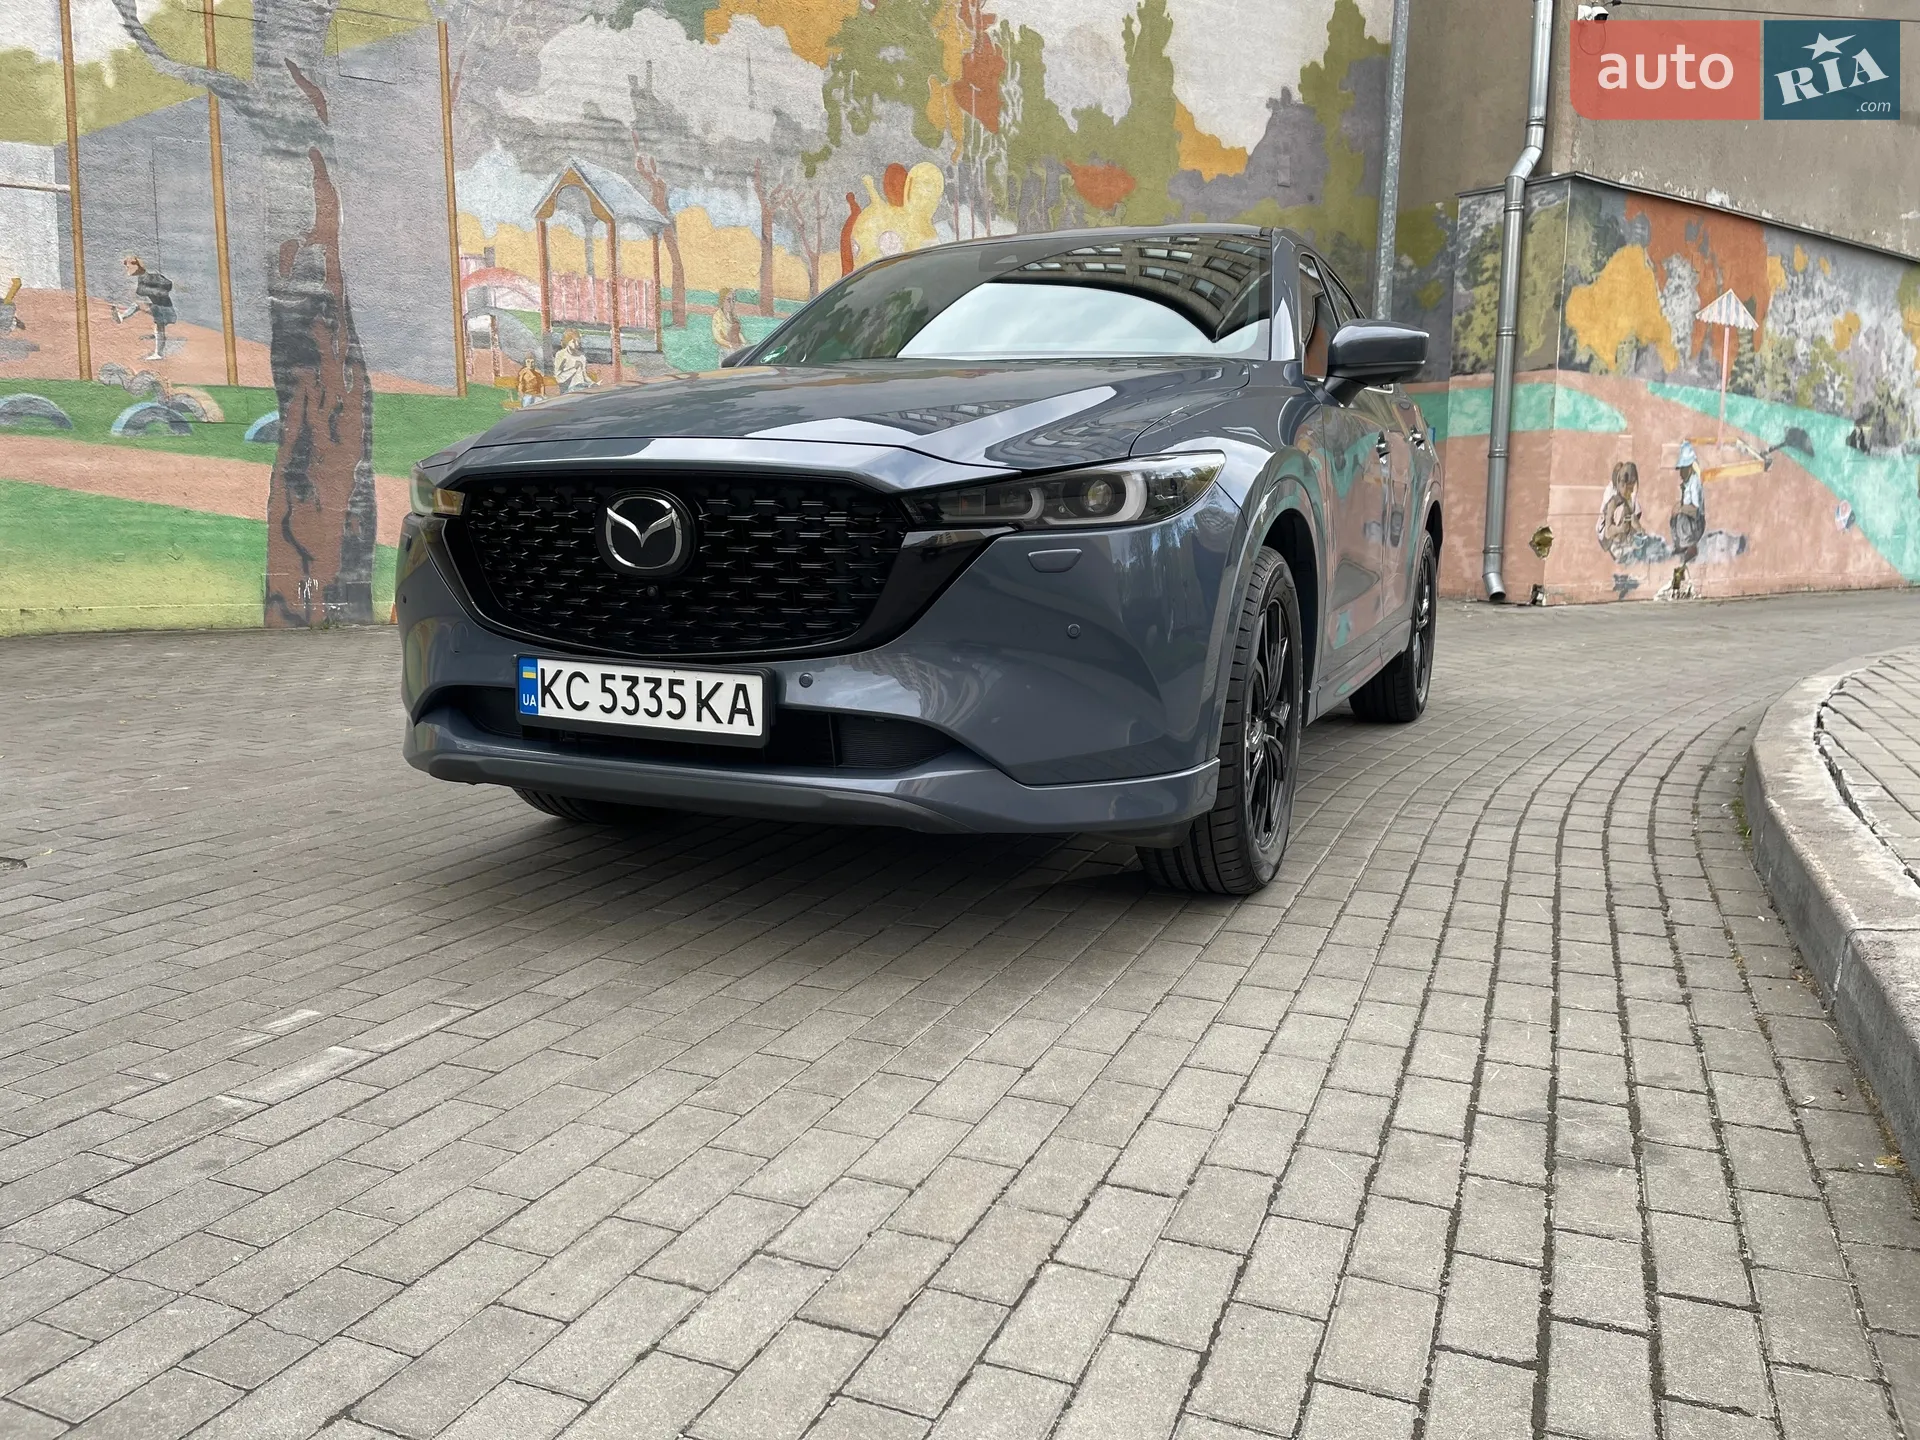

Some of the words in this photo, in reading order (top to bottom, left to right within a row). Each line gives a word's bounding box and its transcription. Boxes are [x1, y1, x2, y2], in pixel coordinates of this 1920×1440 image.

[522, 693, 537, 707] UA
[540, 667, 590, 711] KC
[598, 673, 687, 720] 5335
[696, 680, 755, 727] KA
